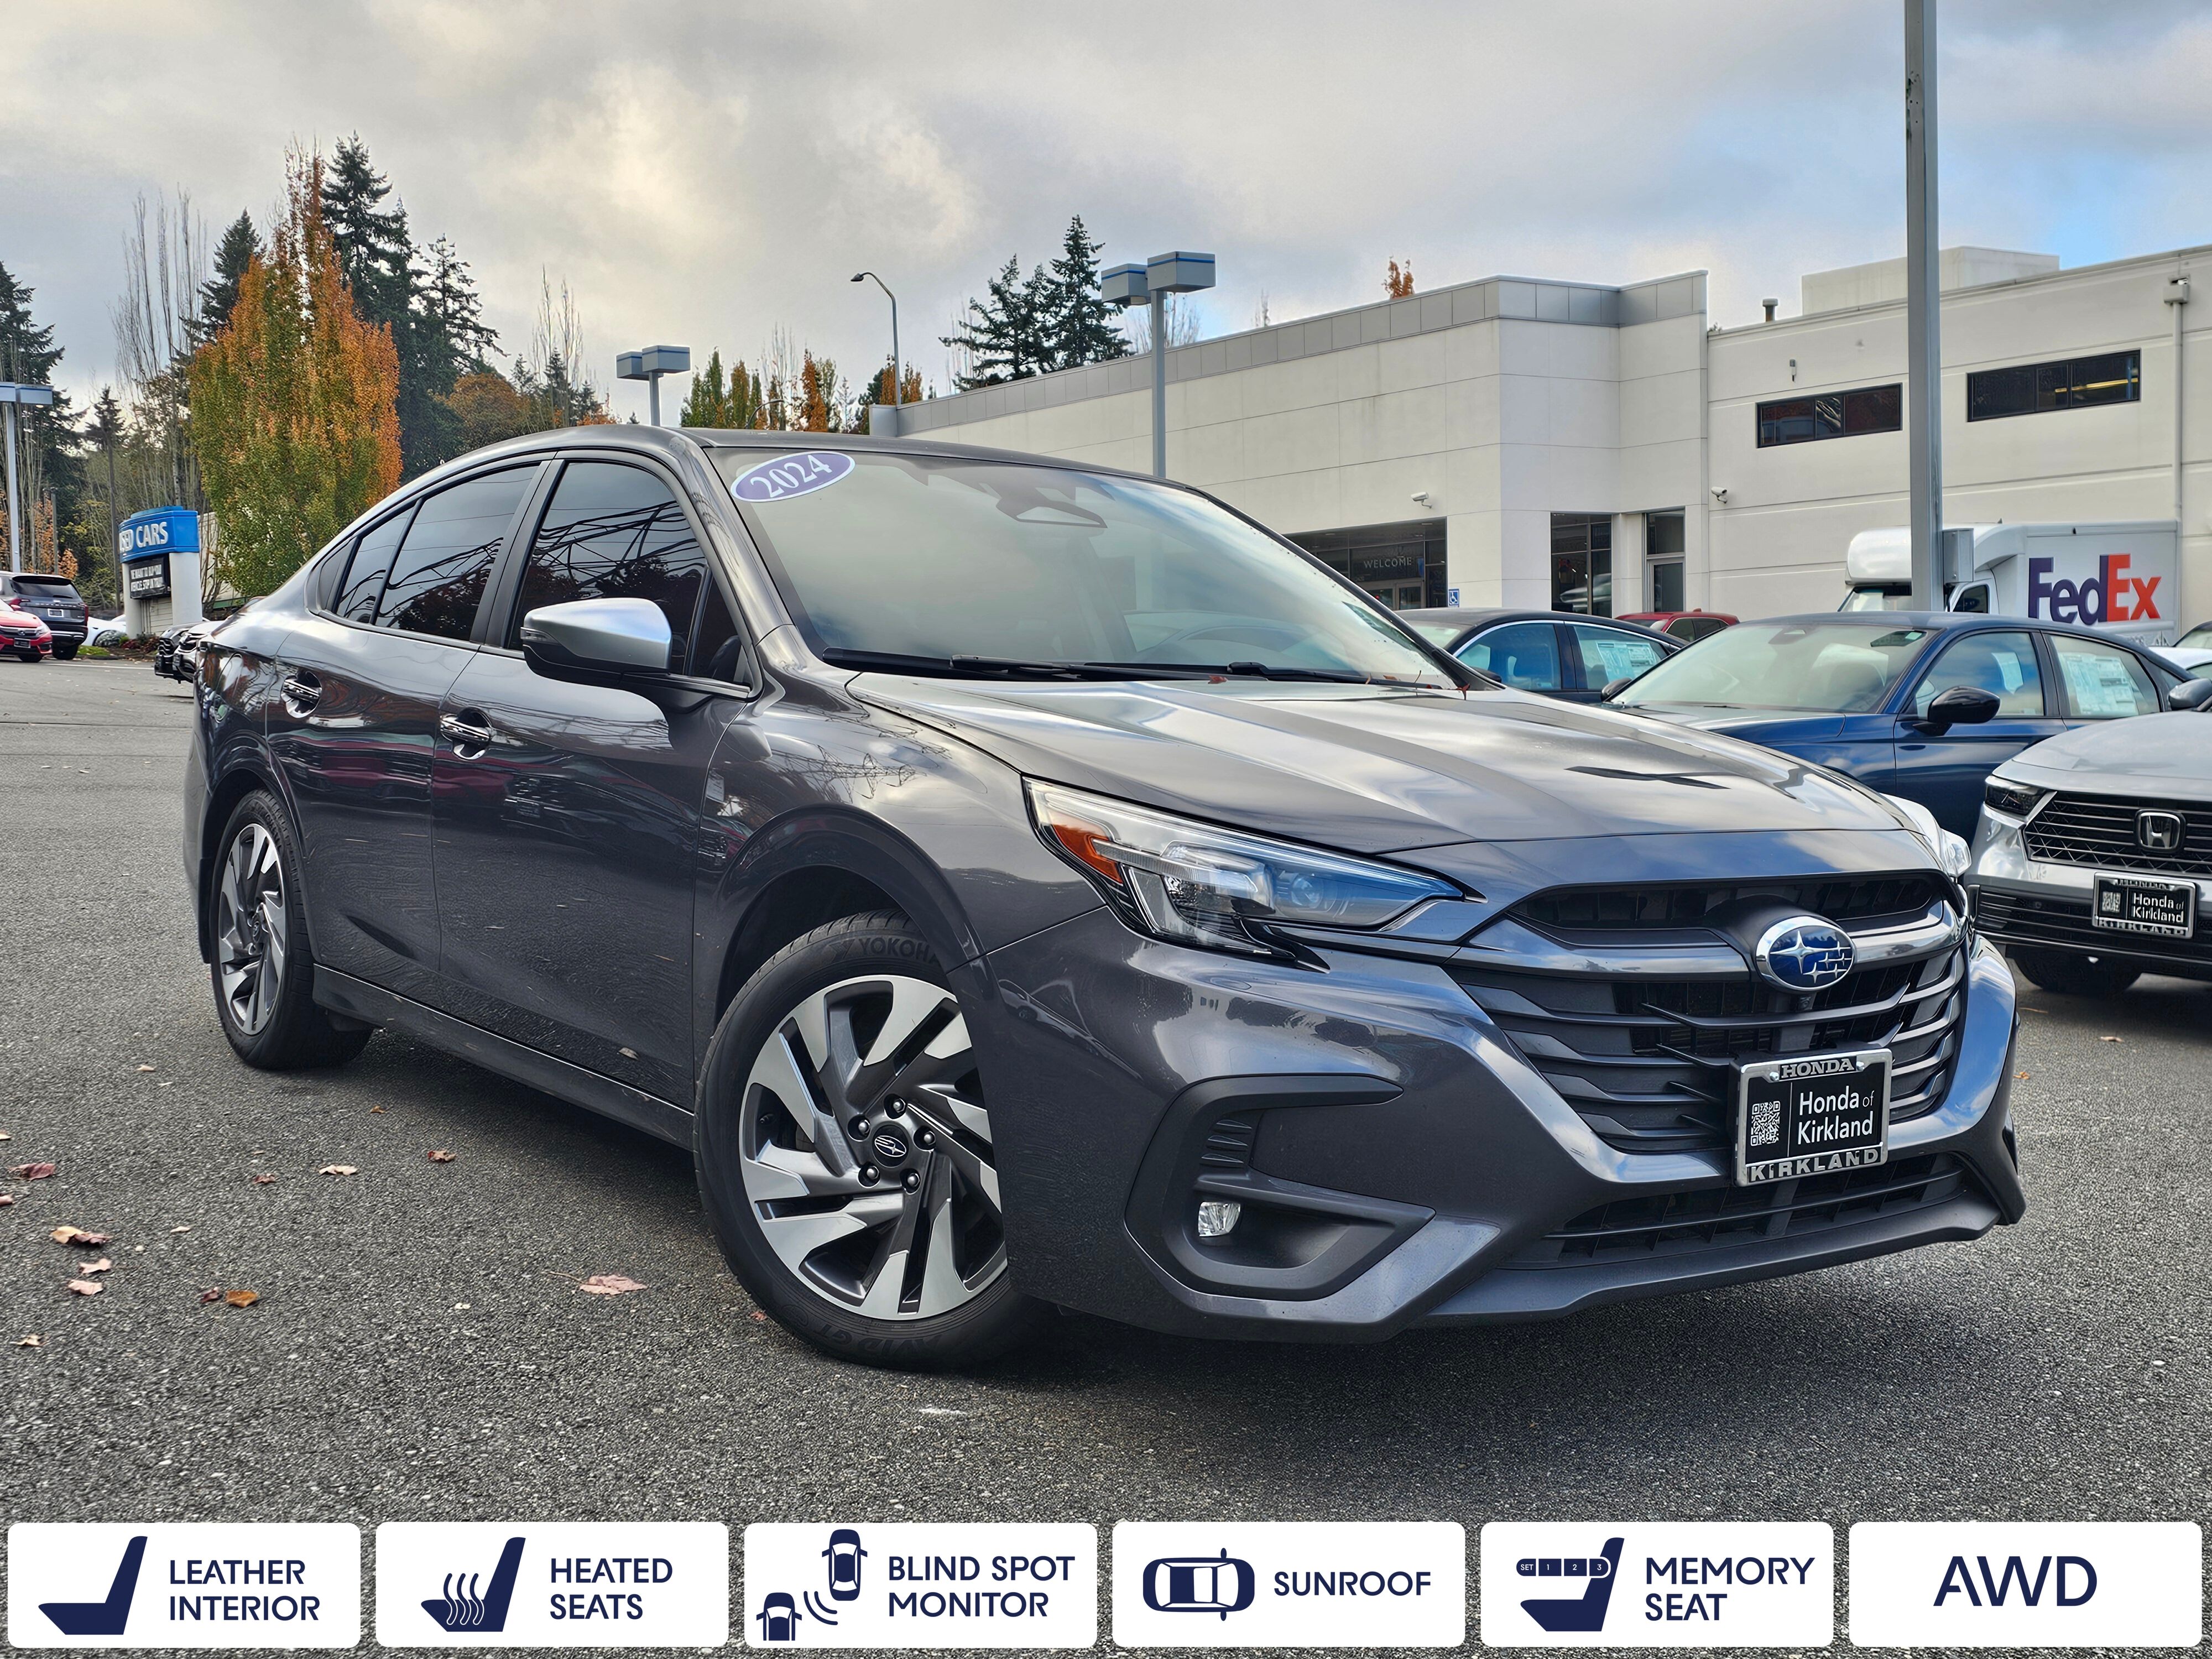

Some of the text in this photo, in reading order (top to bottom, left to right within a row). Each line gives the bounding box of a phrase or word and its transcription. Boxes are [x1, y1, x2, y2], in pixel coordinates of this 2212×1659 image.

[750, 455, 832, 498] 2024
[136, 521, 169, 548] CARS
[1363, 556, 1412, 569] WELCOME
[2028, 553, 2162, 626] FedEx
[2132, 905, 2184, 924] Kirkland
[2133, 892, 2174, 909] Honda
[1781, 1057, 1855, 1079] HONDA
[1799, 1085, 1875, 1116] Honda of
[1797, 1110, 1874, 1145] Kirkland
[1750, 1148, 1879, 1182] KIRKLAND
